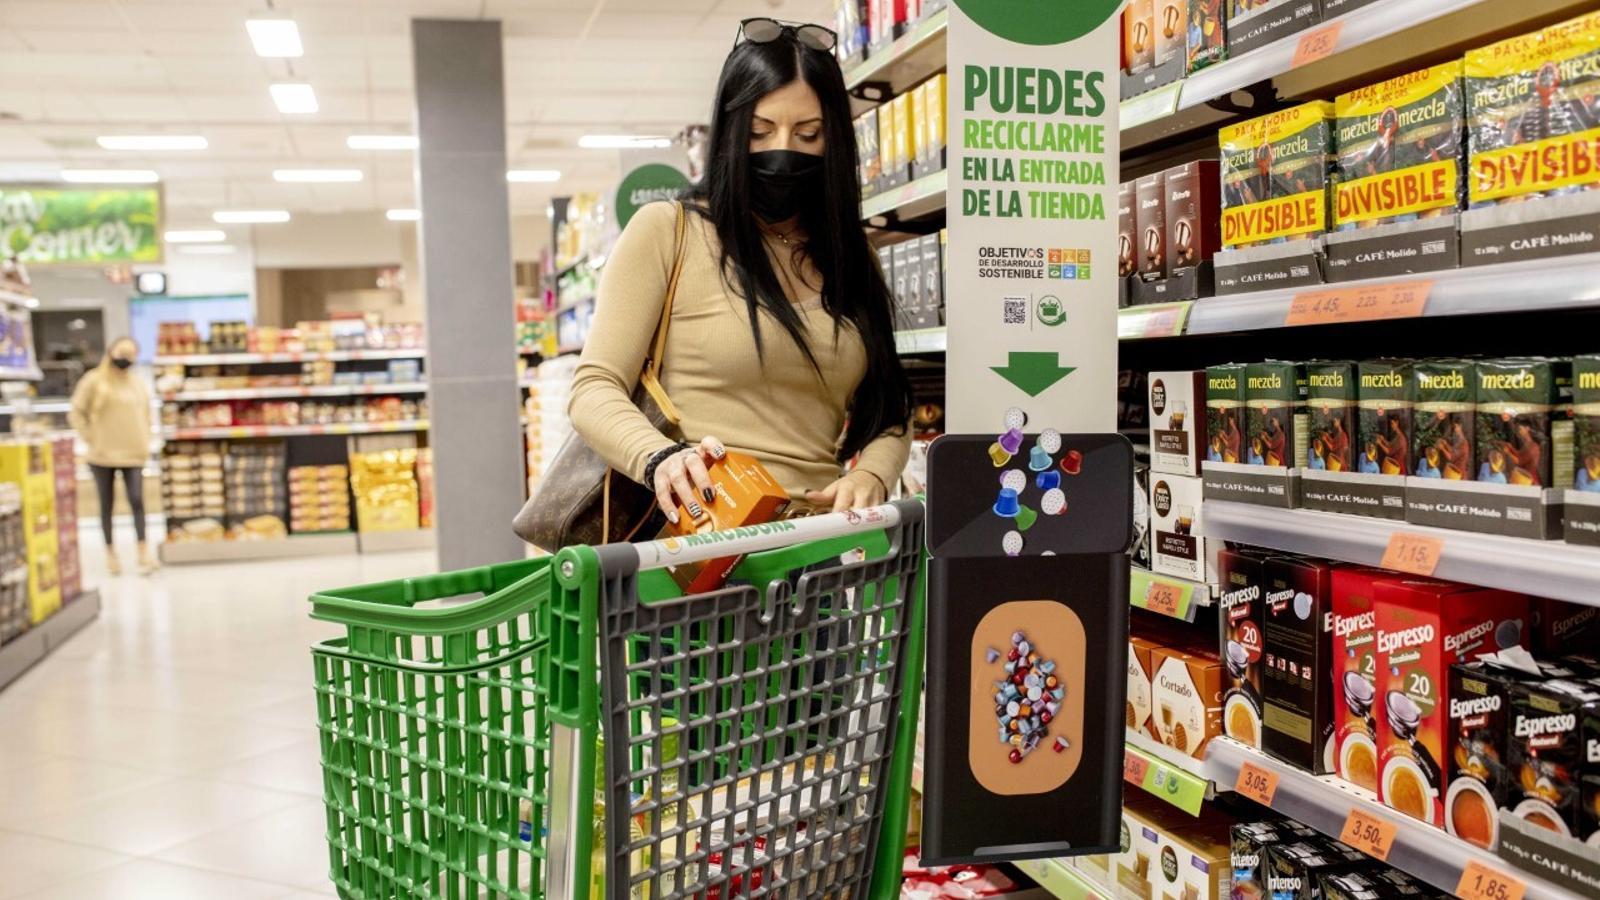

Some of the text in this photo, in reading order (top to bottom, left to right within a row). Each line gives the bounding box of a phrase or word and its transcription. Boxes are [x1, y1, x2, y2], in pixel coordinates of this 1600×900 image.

[1494, 42, 1530, 59] PACK
[964, 65, 1106, 117] PUEDES
[1350, 85, 1377, 102] PACK
[1474, 77, 1530, 108] mezcla
[1398, 100, 1447, 128] mezcla
[963, 119, 1105, 154] RECICLARME
[1340, 115, 1380, 142] mezcla
[1272, 136, 1309, 160] mezcla
[963, 157, 1106, 185] EN LA ENTRADA
[1338, 168, 1447, 218] DIVISIBLE
[963, 189, 1106, 220] DE LA TIENDA
[1225, 197, 1316, 242] DIVISIBLE
[1510, 233, 1550, 251] CAFÉ
[1551, 231, 1594, 246] Molido
[979, 247, 1044, 258] OBJETIVOS
[1355, 251, 1385, 263] CAFÉ
[1386, 247, 1417, 259] Molido
[979, 259, 1044, 268] DE DESARROLLO
[979, 268, 1044, 279] SOSTENIBLE
[1241, 271, 1264, 284] CAFÉ
[1264, 270, 1288, 281] Molido
[1209, 374, 1237, 390] mezcla
[1248, 373, 1282, 389] mezcla
[1310, 370, 1344, 387] mezcla
[1361, 370, 1403, 388] mezcla
[1420, 370, 1465, 389] mezcla
[1482, 369, 1536, 389] mezcla
[1223, 480, 1243, 492] CAFÉ
[1327, 493, 1352, 504] CAFÉ
[1353, 495, 1380, 506] Molido
[1436, 503, 1467, 515] CAFÉ
[1469, 506, 1502, 519] Molido
[1220, 585, 1260, 612] Espresso
[1266, 588, 1295, 608] Espresso
[1243, 626, 1257, 644] 20
[1377, 624, 1435, 656] Espresso
[1444, 619, 1495, 653] Espresso
[1160, 675, 1192, 698] Cortado
[1410, 673, 1430, 697] 20
[1450, 694, 1501, 720] Espresso
[1515, 713, 1576, 739] Espresso
[1532, 853, 1569, 876] CAFÉ
[1267, 874, 1301, 892] Intenso
